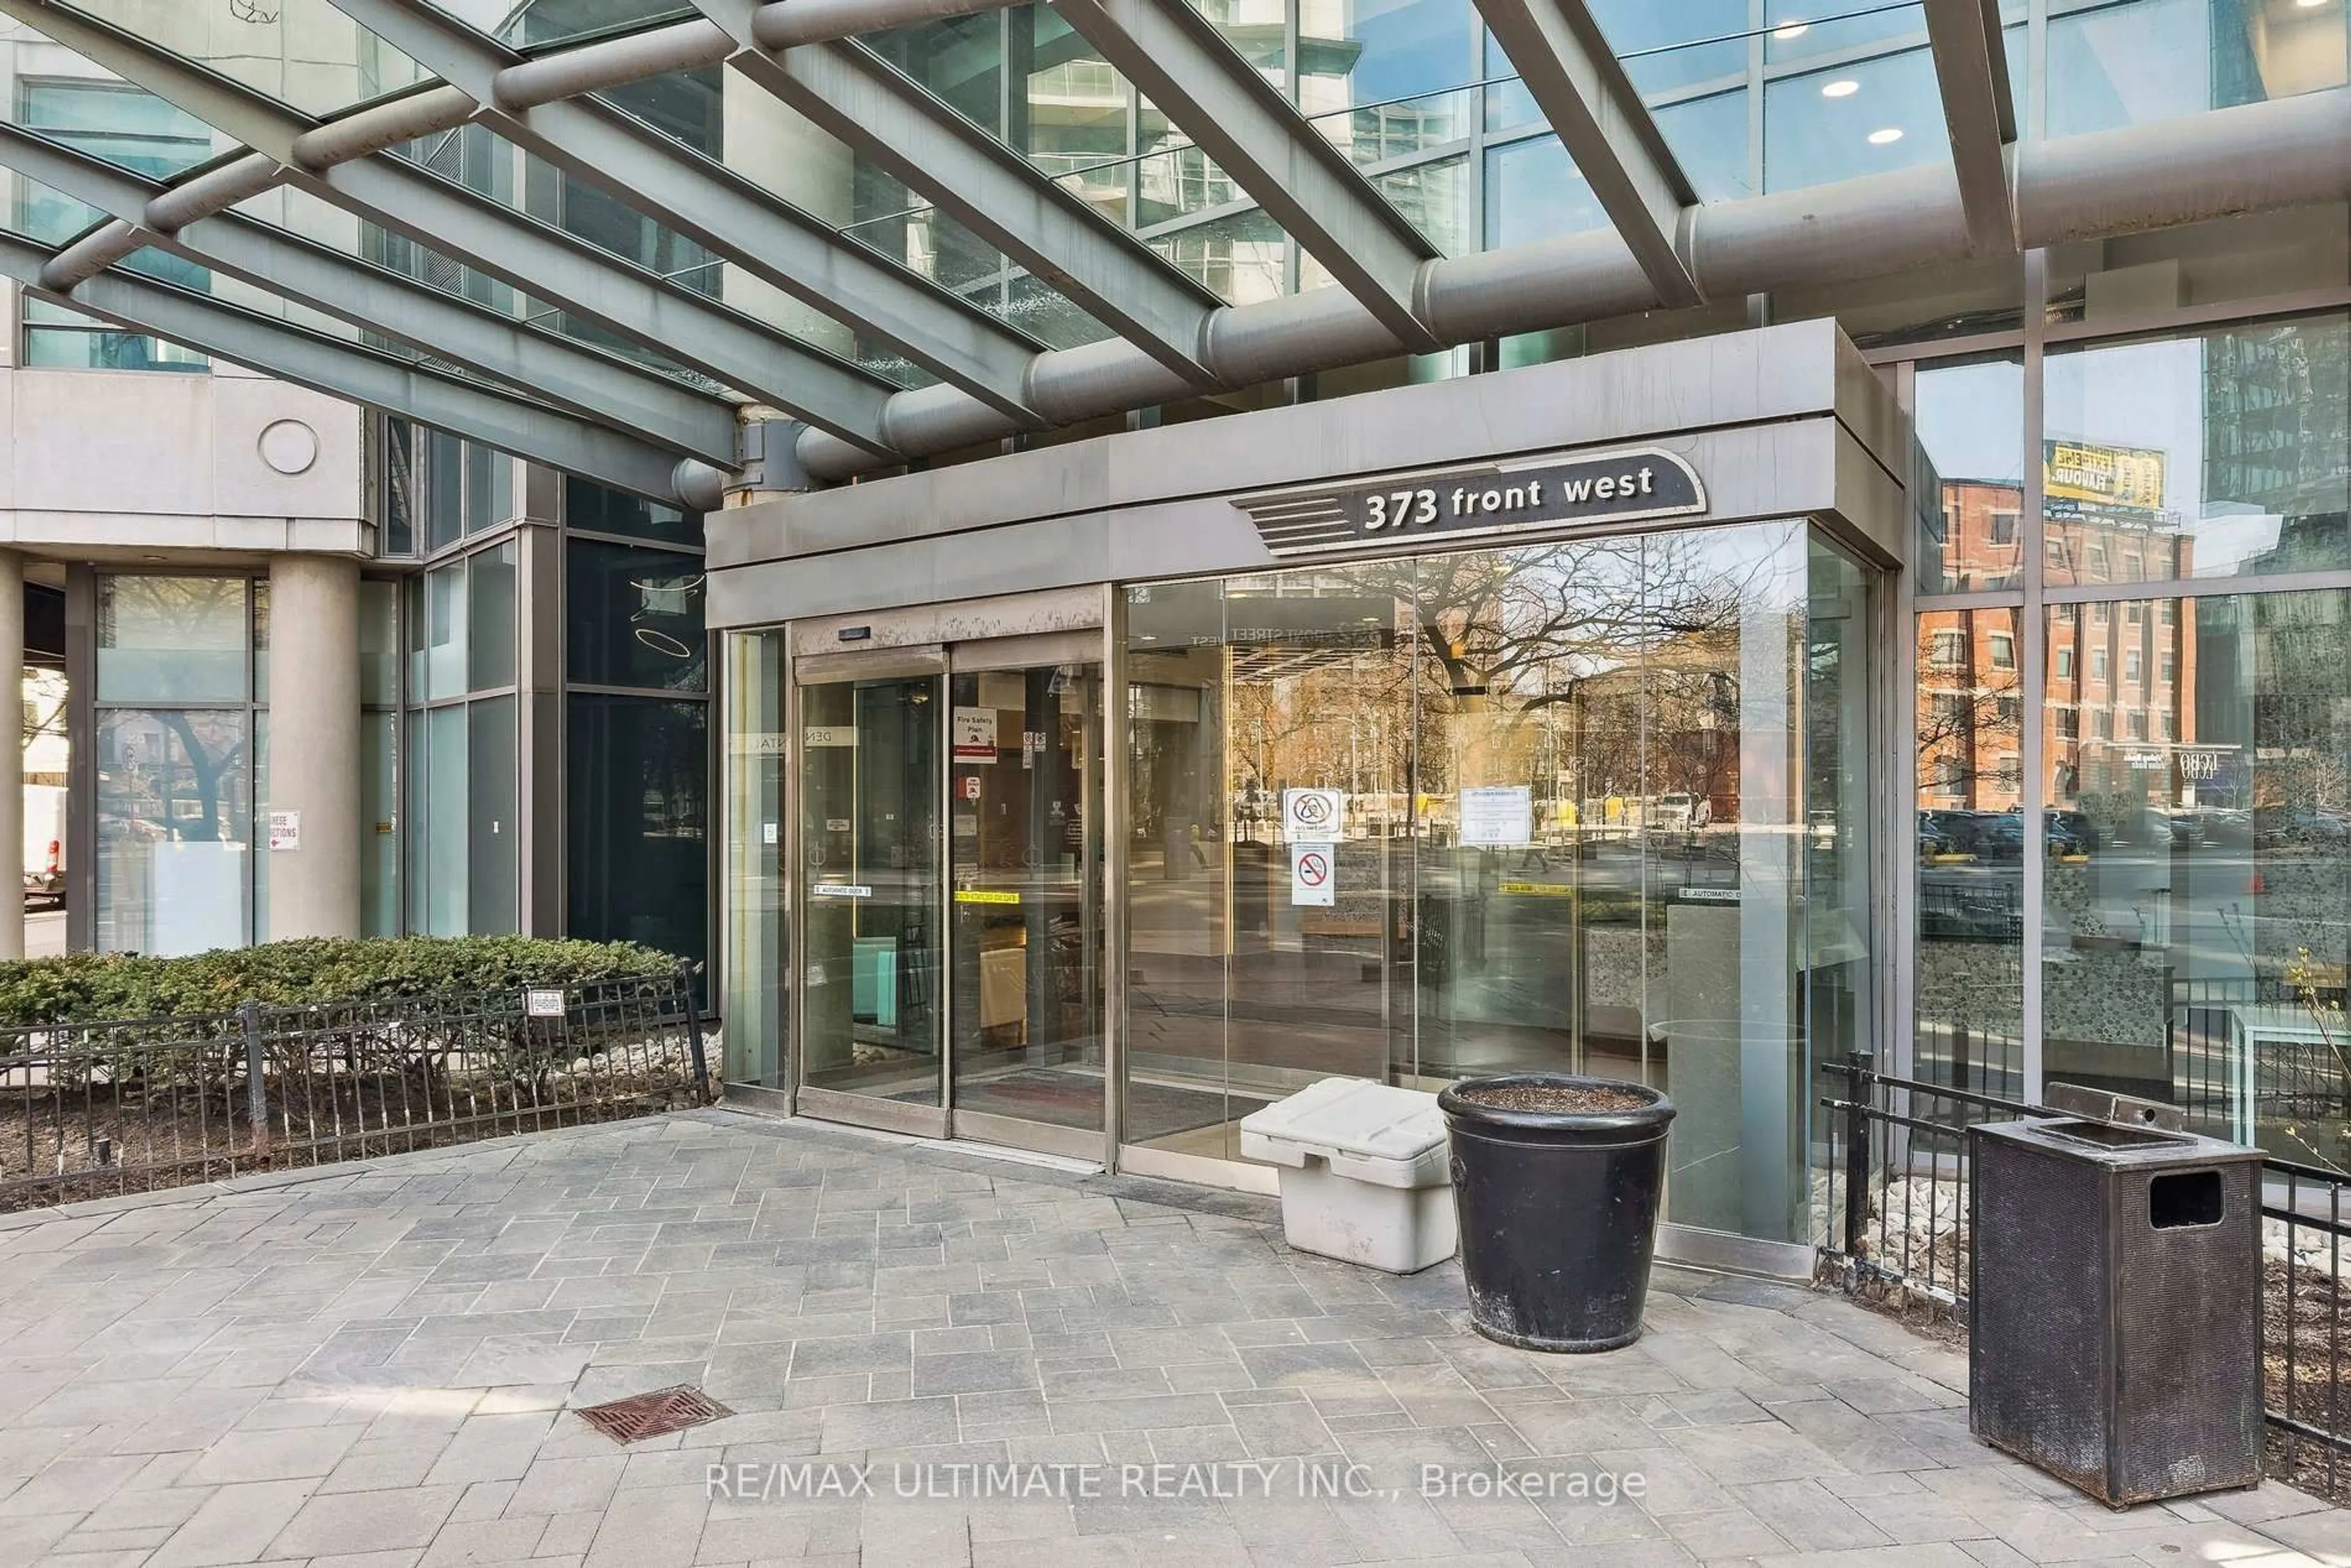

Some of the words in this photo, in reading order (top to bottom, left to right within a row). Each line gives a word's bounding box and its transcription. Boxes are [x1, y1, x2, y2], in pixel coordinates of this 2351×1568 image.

[1365, 489, 1438, 531] 373
[1451, 481, 1542, 516] front
[1563, 467, 1653, 503] west
